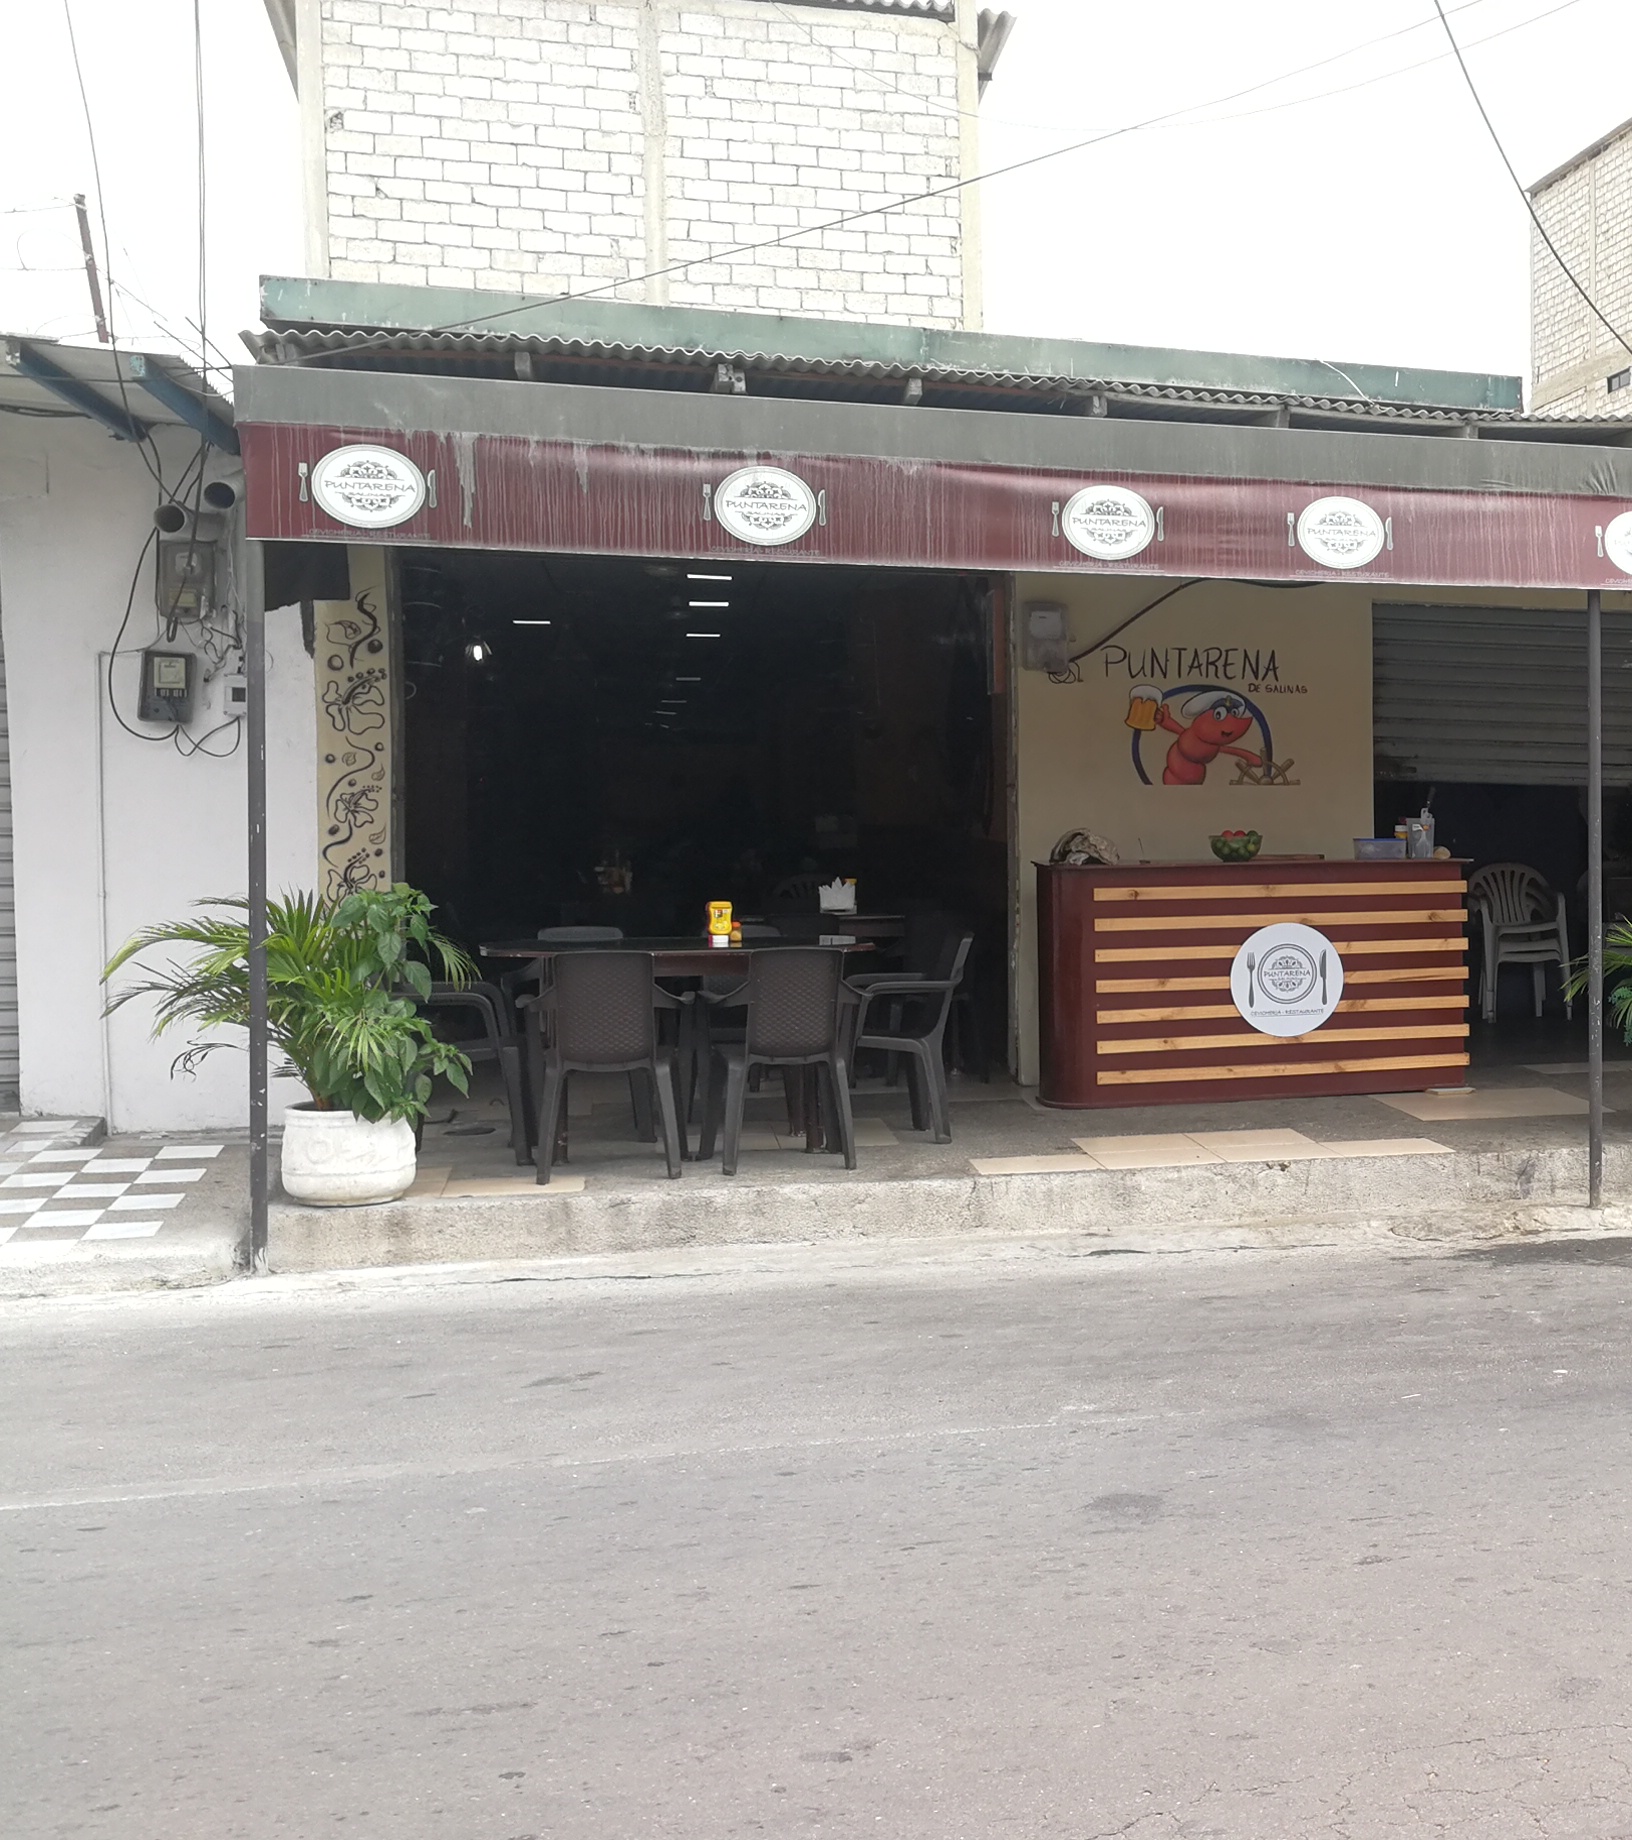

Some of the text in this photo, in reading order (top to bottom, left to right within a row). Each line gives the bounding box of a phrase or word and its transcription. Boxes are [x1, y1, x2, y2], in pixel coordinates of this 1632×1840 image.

[324, 480, 416, 492] PUNTARENA
[725, 500, 808, 511] PUNTARENA
[1072, 517, 1147, 527] PUNTARENA
[1101, 645, 1280, 682] PUNTARENA
[1248, 682, 1308, 694] DE SALINAS
